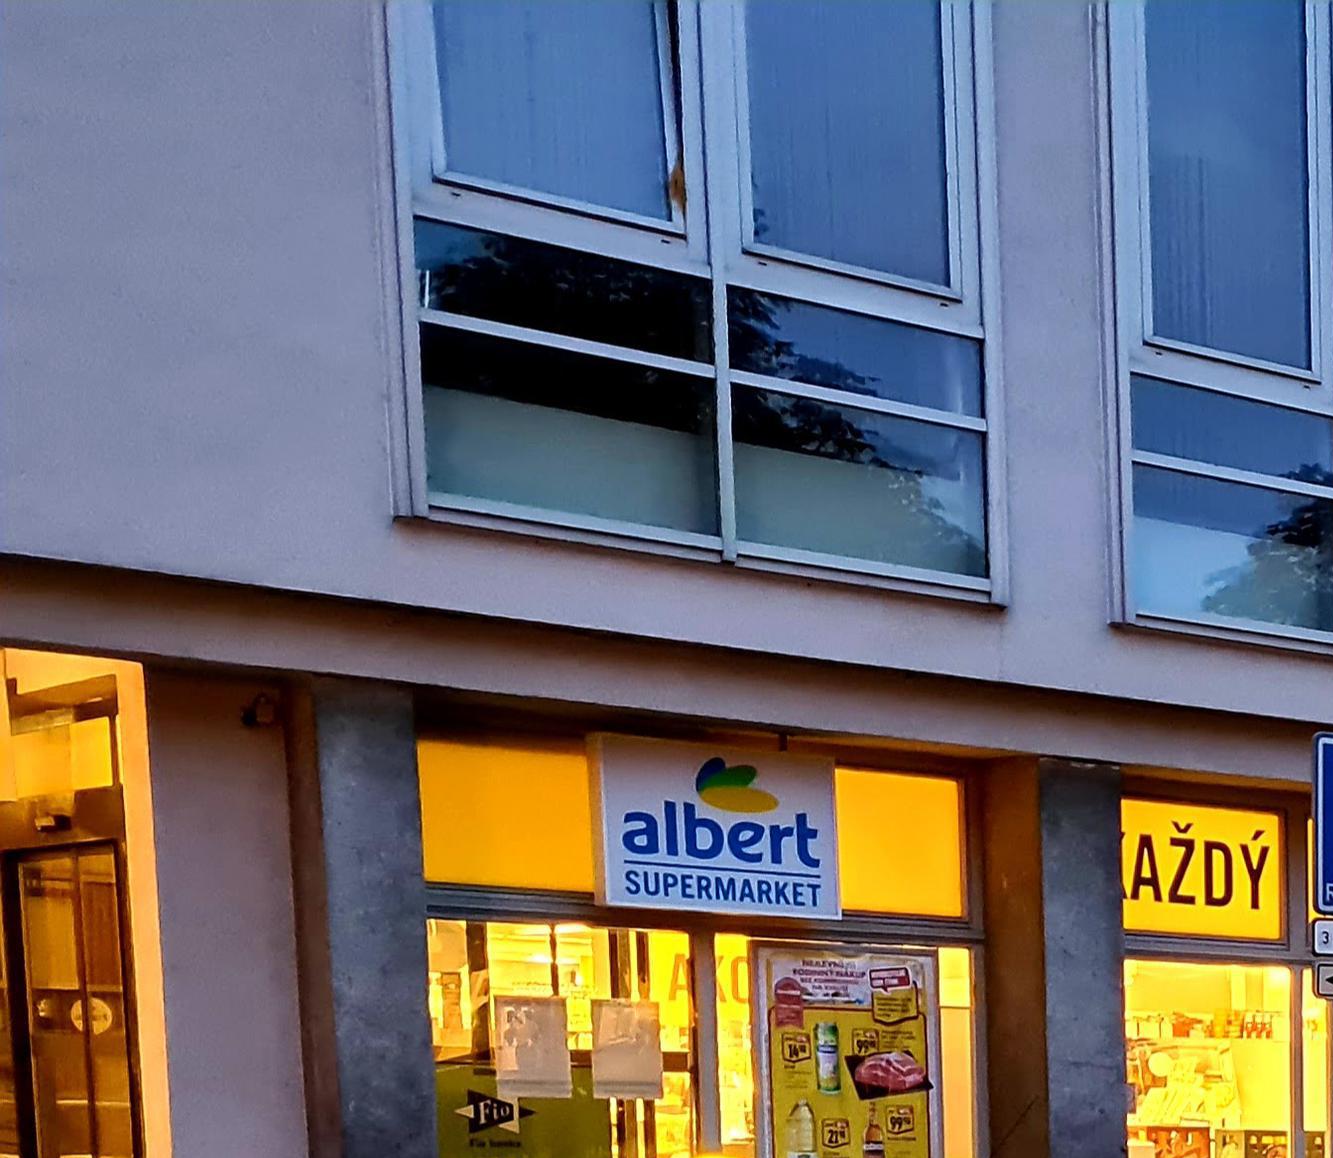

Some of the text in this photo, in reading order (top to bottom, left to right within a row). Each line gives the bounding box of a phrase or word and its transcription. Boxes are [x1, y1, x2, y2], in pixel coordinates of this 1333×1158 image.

[622, 800, 821, 868] albert
[1121, 820, 1270, 910] AŽDÝ
[624, 870, 822, 907] SUPERMARKET
[1321, 931, 1330, 945] 3
[479, 1100, 510, 1125] Fio
